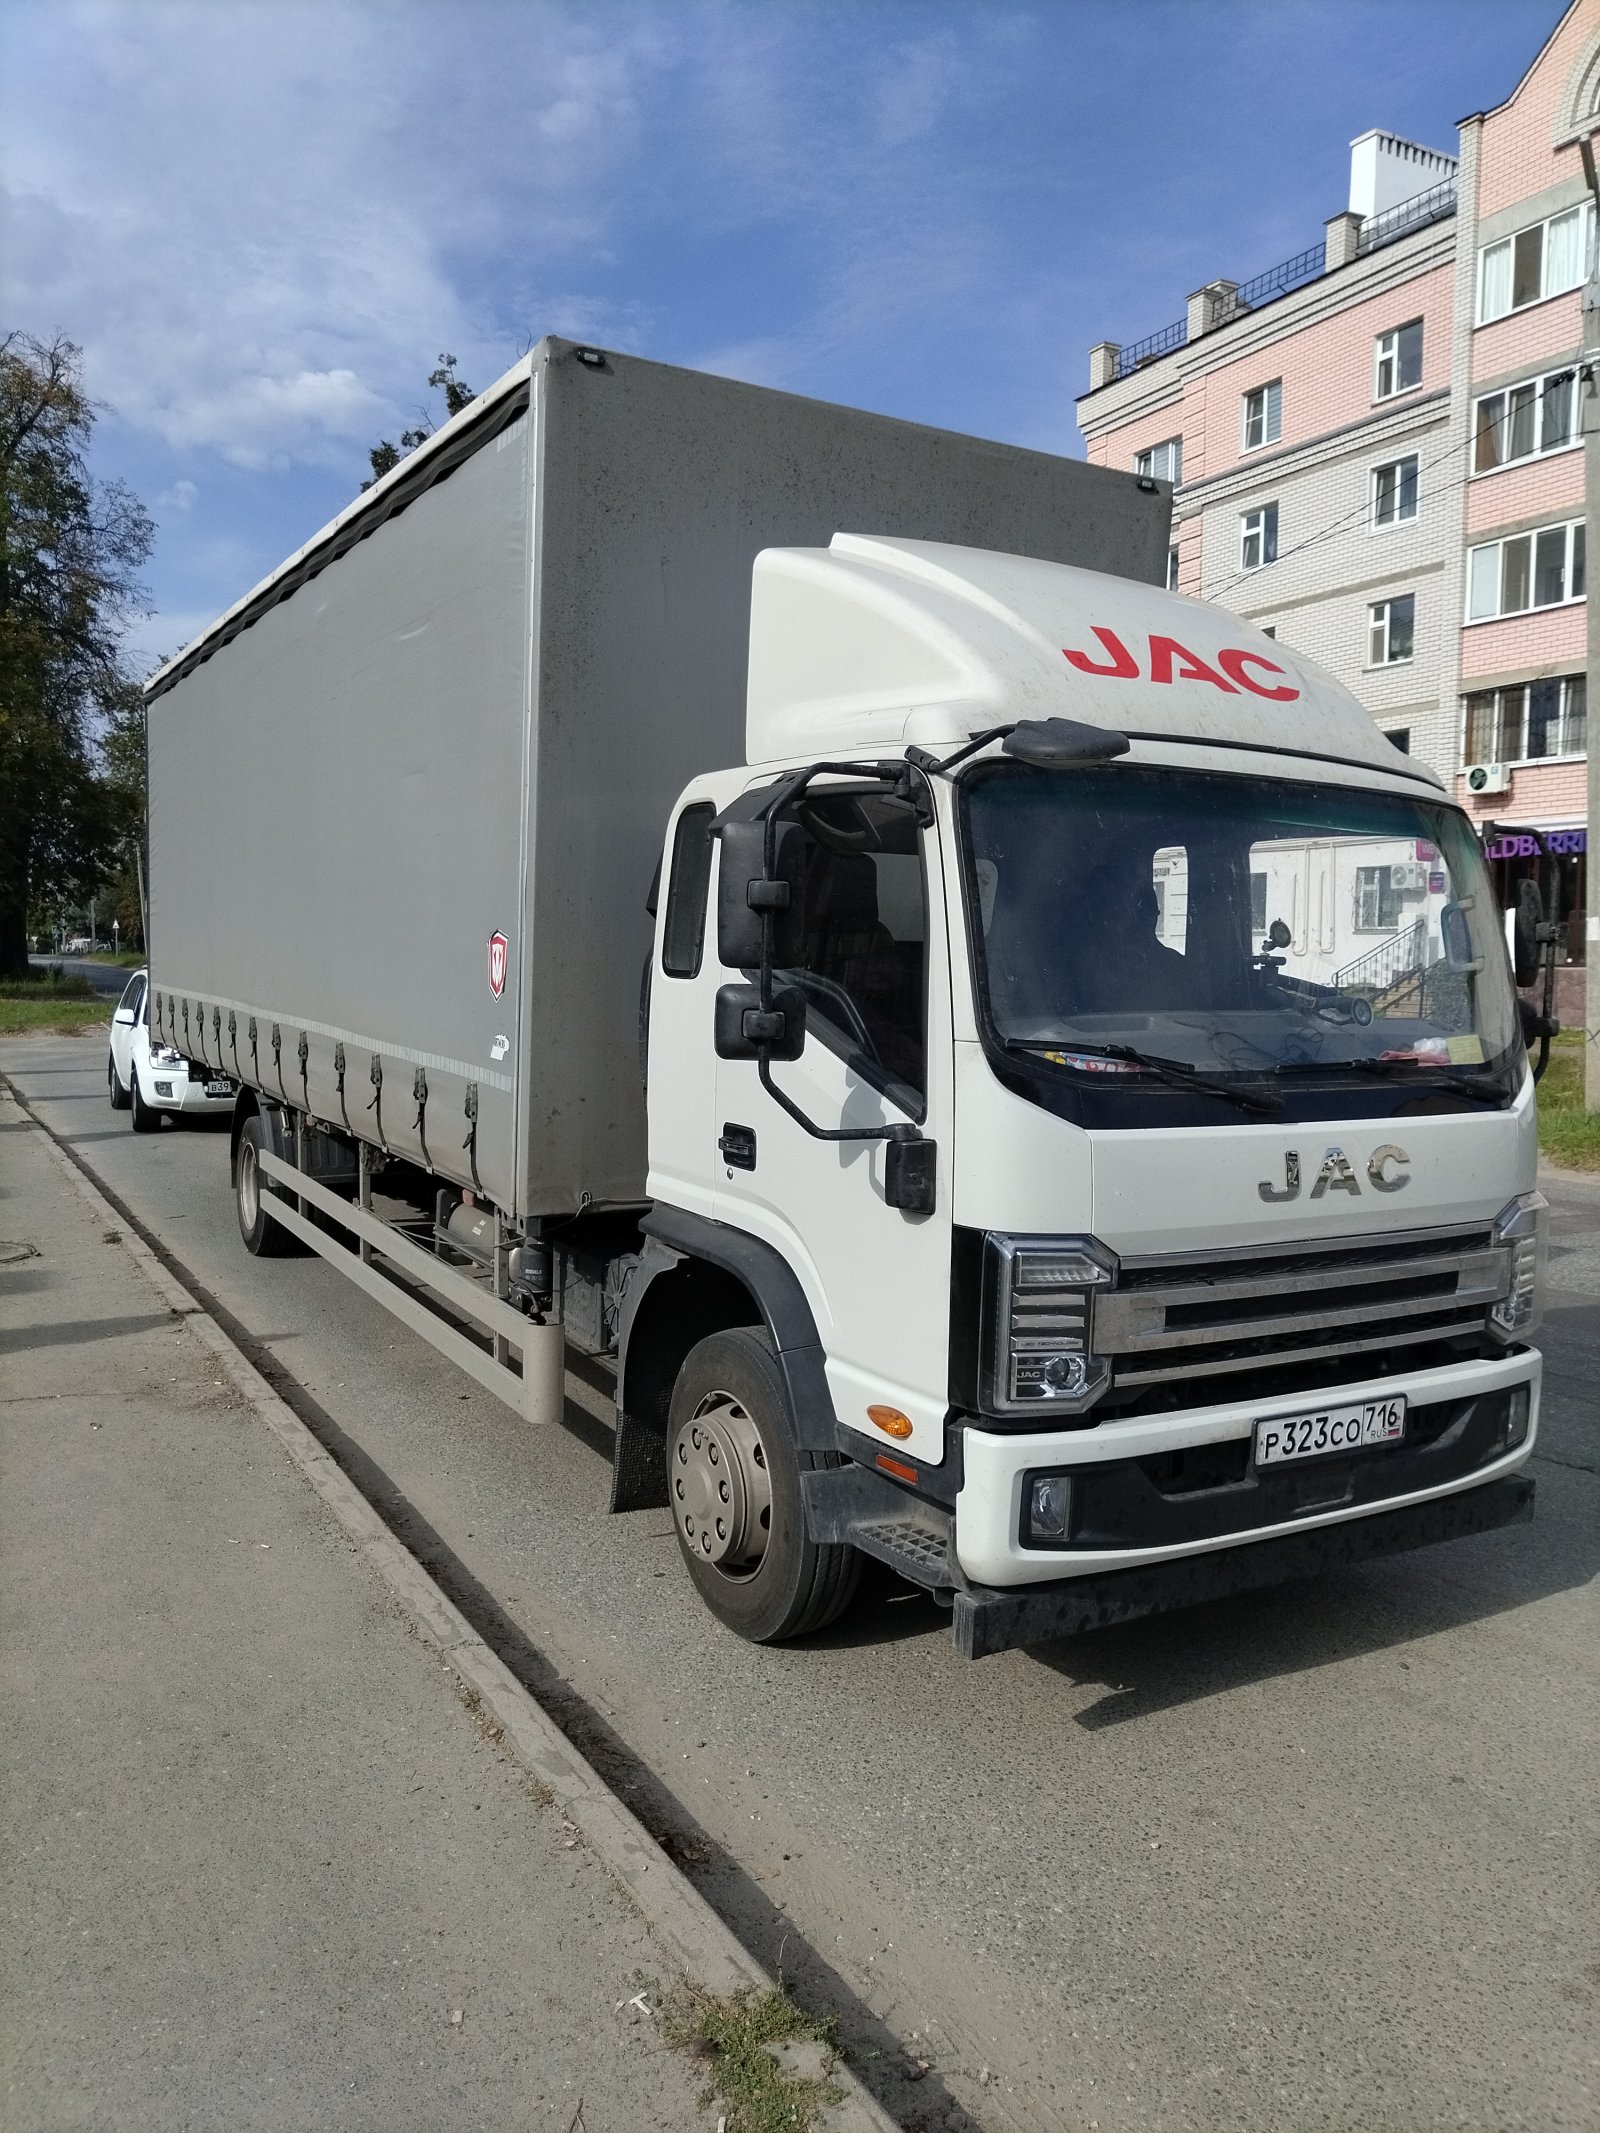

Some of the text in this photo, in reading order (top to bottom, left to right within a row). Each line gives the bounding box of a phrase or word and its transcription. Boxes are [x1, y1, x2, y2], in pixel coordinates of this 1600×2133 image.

[1062, 625, 1300, 702] JAC
[1257, 1144, 1411, 1203] JAC
[1264, 1402, 1397, 1459] Р323СО 716
[1370, 1427, 1387, 1440] RUS
